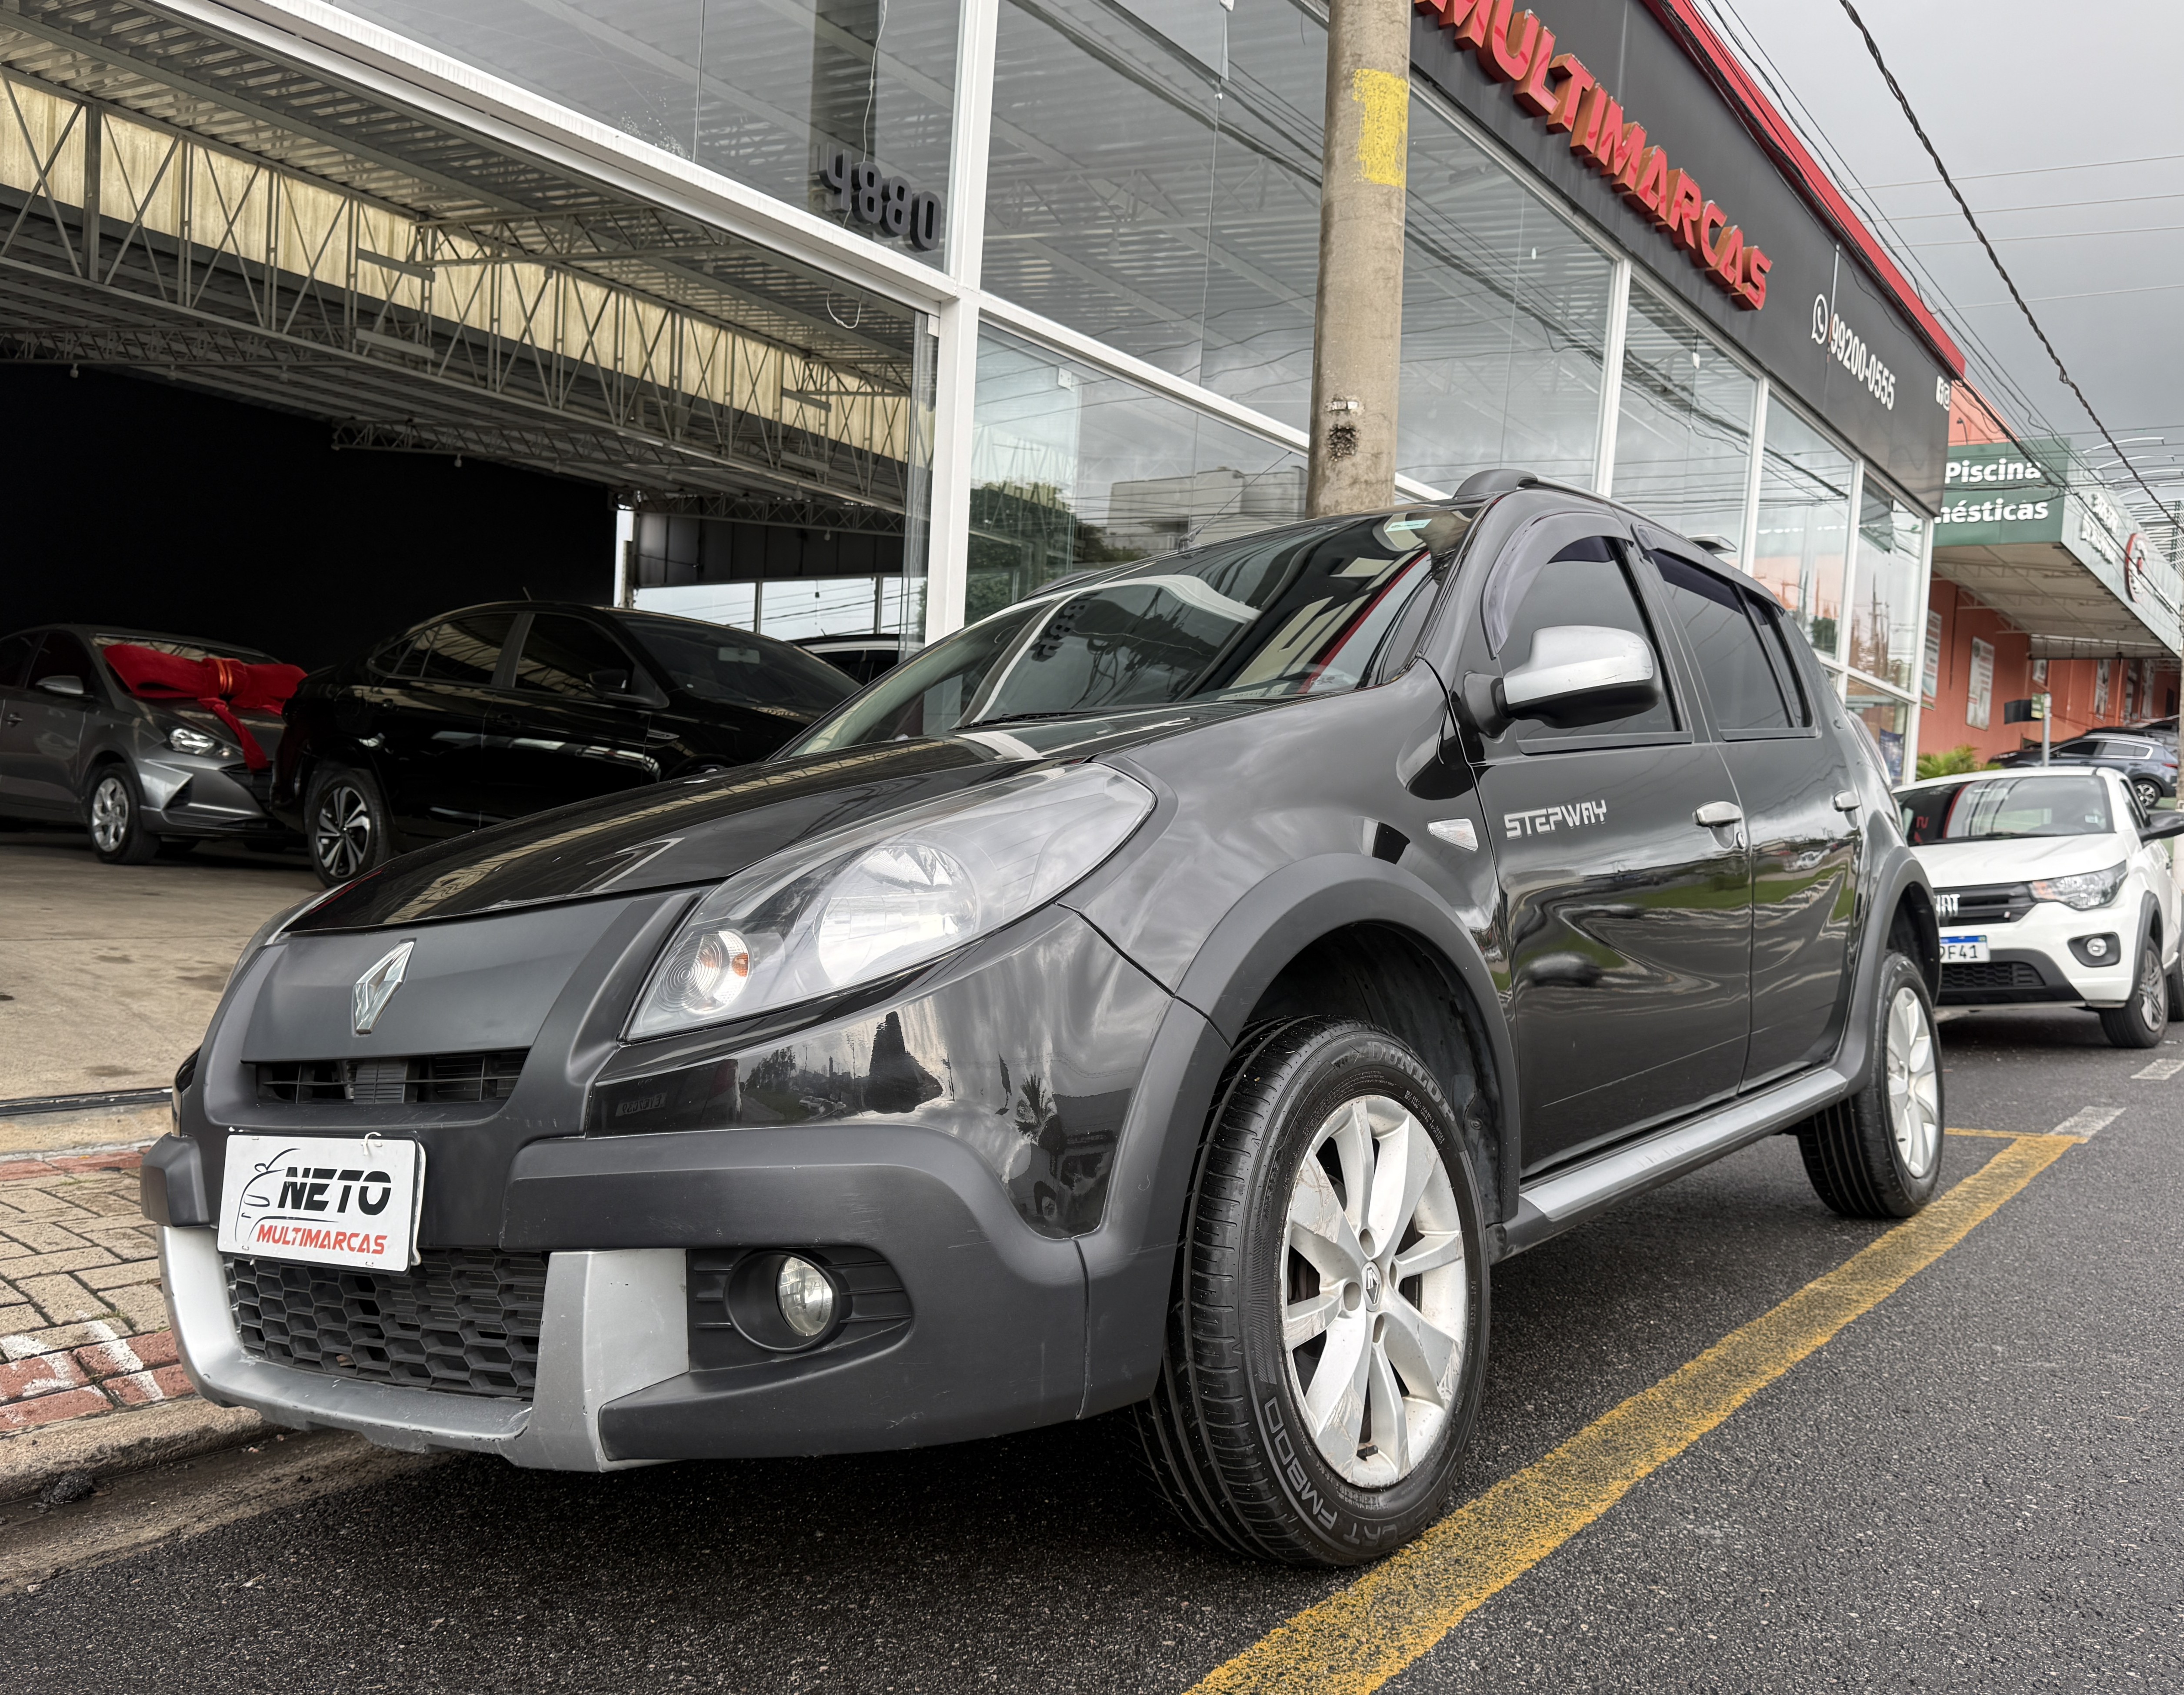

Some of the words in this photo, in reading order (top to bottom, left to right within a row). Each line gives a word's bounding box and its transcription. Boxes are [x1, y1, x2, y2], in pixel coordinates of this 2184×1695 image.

[820, 142, 941, 251] 4880
[1830, 313, 1896, 410] 99200-0555
[1944, 458, 2042, 484] Piscina
[1504, 799, 1607, 840] STEPWAY
[1933, 894, 1961, 917] IAT
[1364, 1041, 1455, 1121] DUNLOP
[277, 1166, 392, 1215] NETO
[256, 1224, 388, 1255] MULTIMARCAS
[1264, 1396, 1338, 1531] FM800
